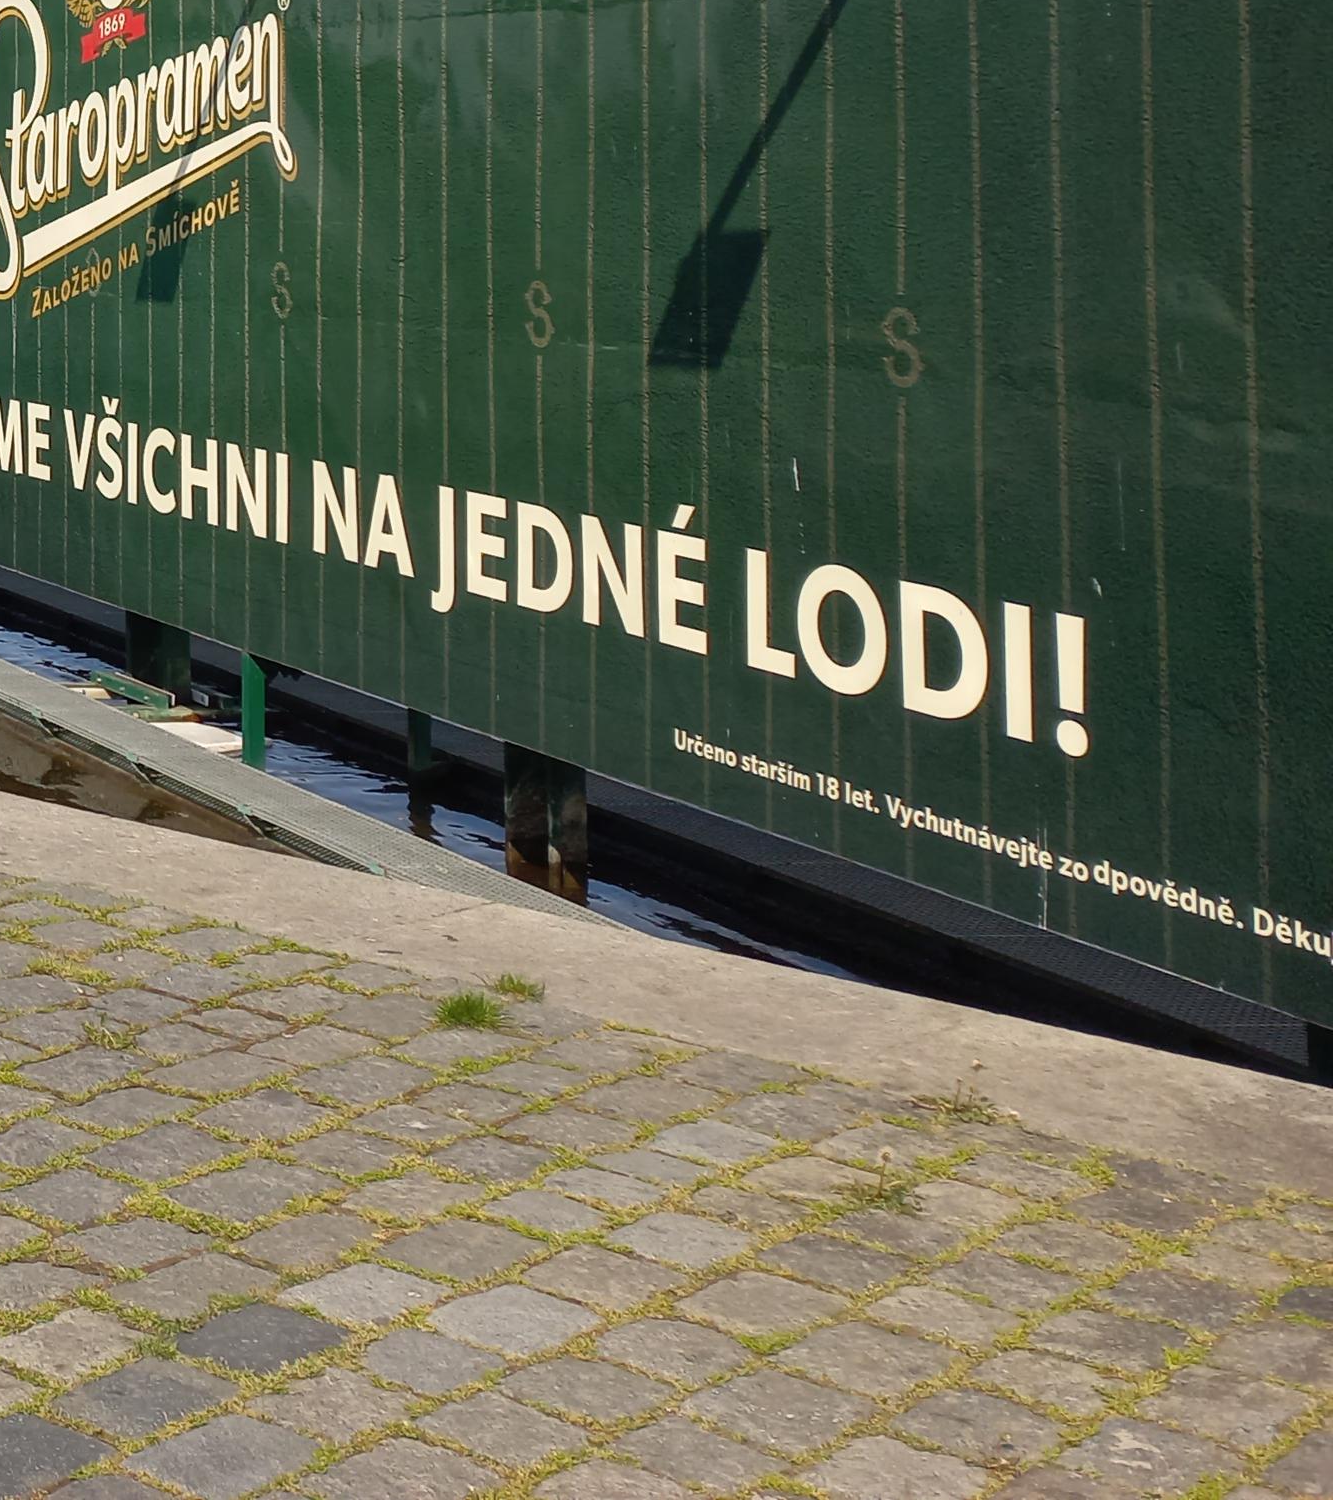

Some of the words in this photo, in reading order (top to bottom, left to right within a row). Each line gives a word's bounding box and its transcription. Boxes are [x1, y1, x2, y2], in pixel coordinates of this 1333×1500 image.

[98, 12, 126, 39] 1869
[32, 257, 112, 318] ZALOŽENO
[118, 243, 139, 272] NA
[145, 179, 239, 257] SMÍCHOVĚ
[881, 307, 926, 388] S
[63, 396, 290, 544] VŠICHNI
[312, 459, 415, 578] NA
[431, 485, 708, 656] JEDNÉ
[745, 547, 1090, 758] LODI!
[674, 728, 737, 768] Určeno
[741, 754, 811, 793] starším
[816, 772, 840, 801] 18
[845, 781, 880, 814] let.
[884, 794, 1054, 870] Vychutnávejte
[1058, 854, 1089, 883] zo
[1093, 860, 1244, 930] dpovědně.
[1254, 906, 1333, 966] Děku
